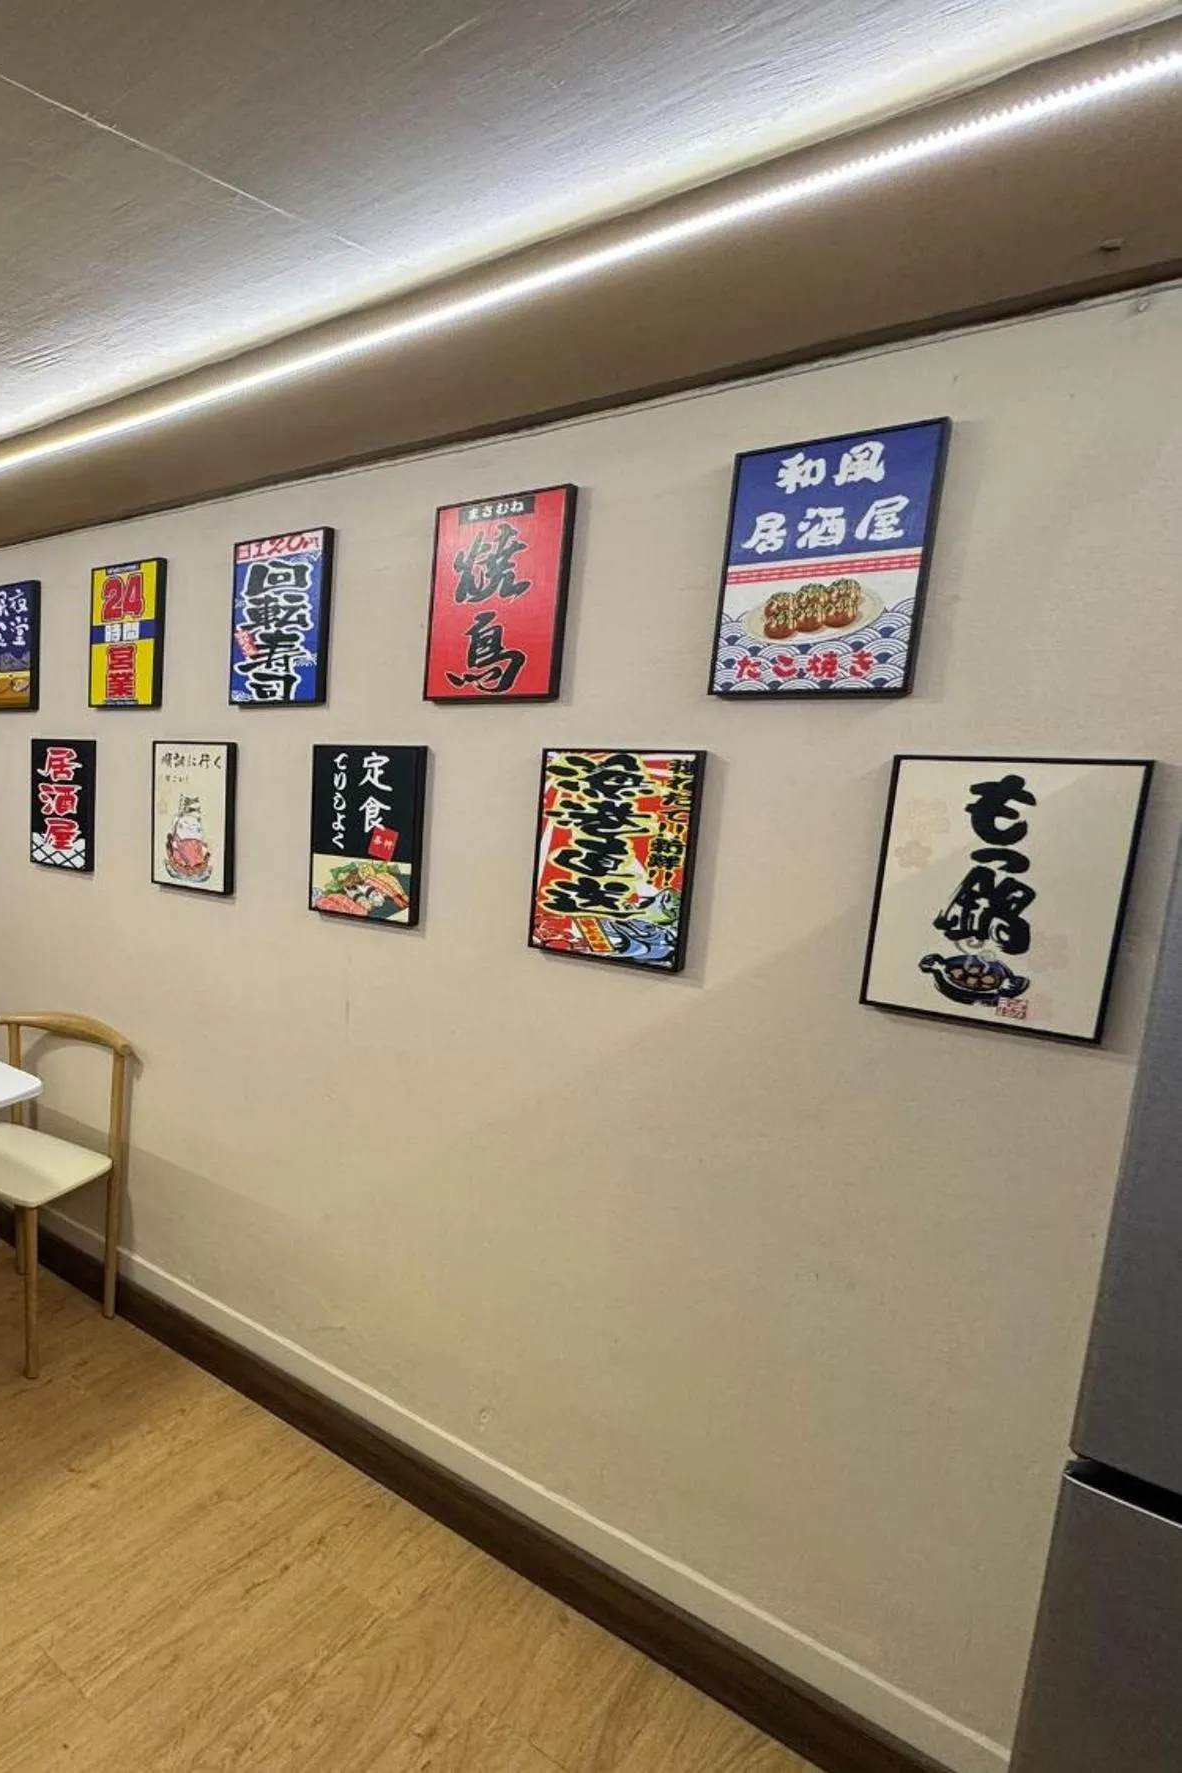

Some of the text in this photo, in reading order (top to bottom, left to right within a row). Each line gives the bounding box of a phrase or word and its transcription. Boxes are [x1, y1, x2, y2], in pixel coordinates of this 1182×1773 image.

[775, 440, 886, 495] 和風
[467, 500, 525, 521] まさむね
[740, 494, 911, 554] 居酒屋
[101, 571, 146, 623] 24
[234, 559, 314, 702] 回転寿司
[445, 522, 533, 694] 焼鳥
[735, 648, 875, 681] たこ焼き
[37, 746, 83, 851] 居酒屋
[358, 751, 394, 834] 定食
[932, 773, 1038, 956] もつ鍋
